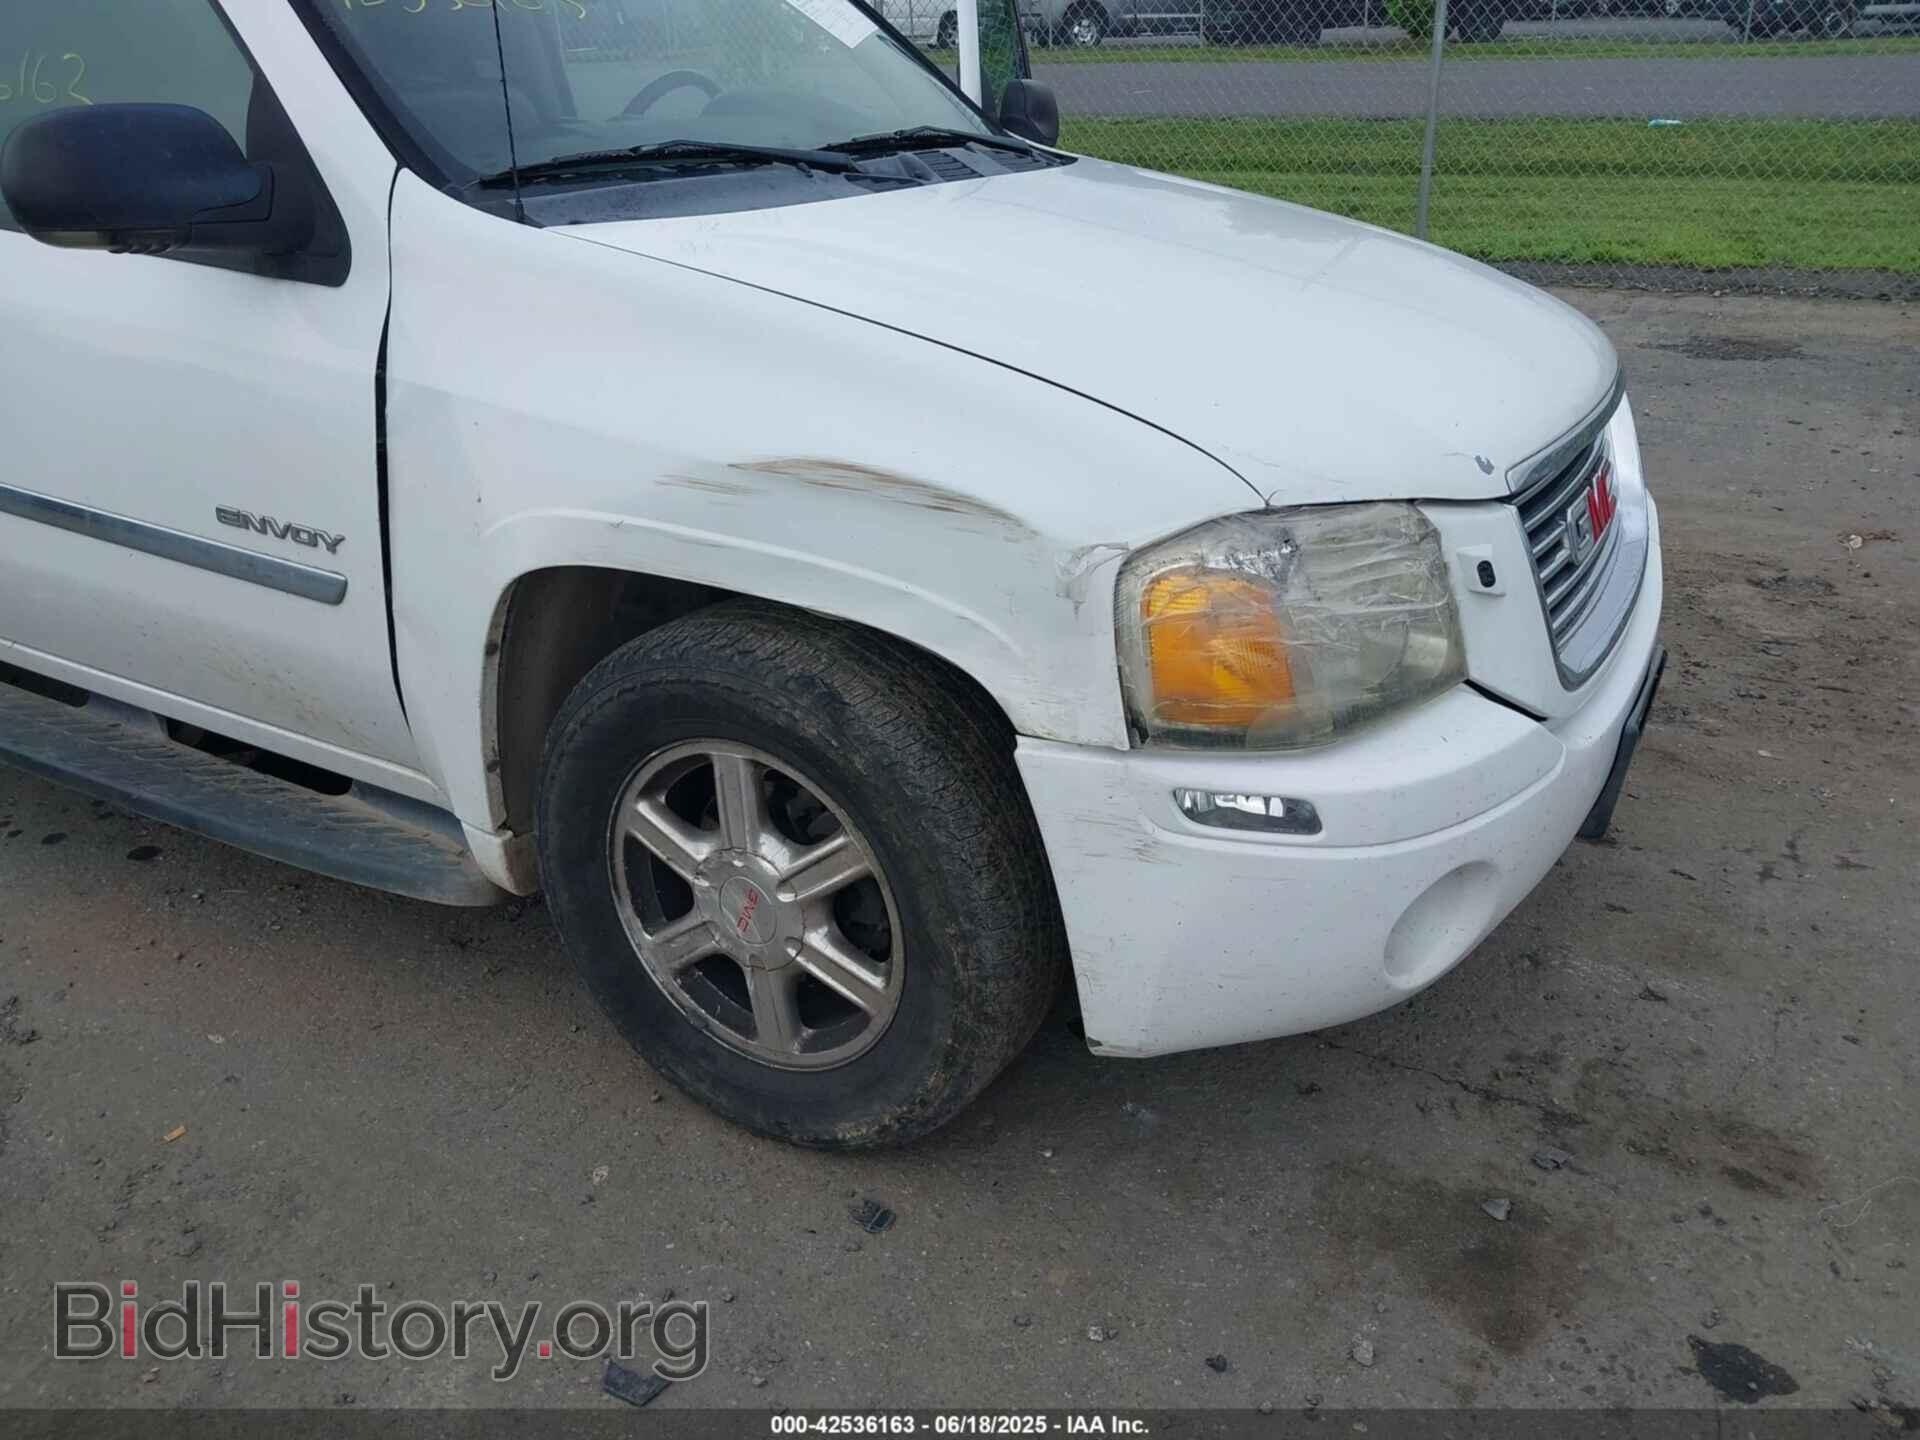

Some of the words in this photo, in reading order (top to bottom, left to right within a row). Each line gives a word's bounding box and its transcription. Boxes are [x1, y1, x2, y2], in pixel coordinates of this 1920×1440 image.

[215, 504, 346, 555] ENVOY
[1567, 457, 1617, 566] GM
[736, 887, 759, 934] GMC
